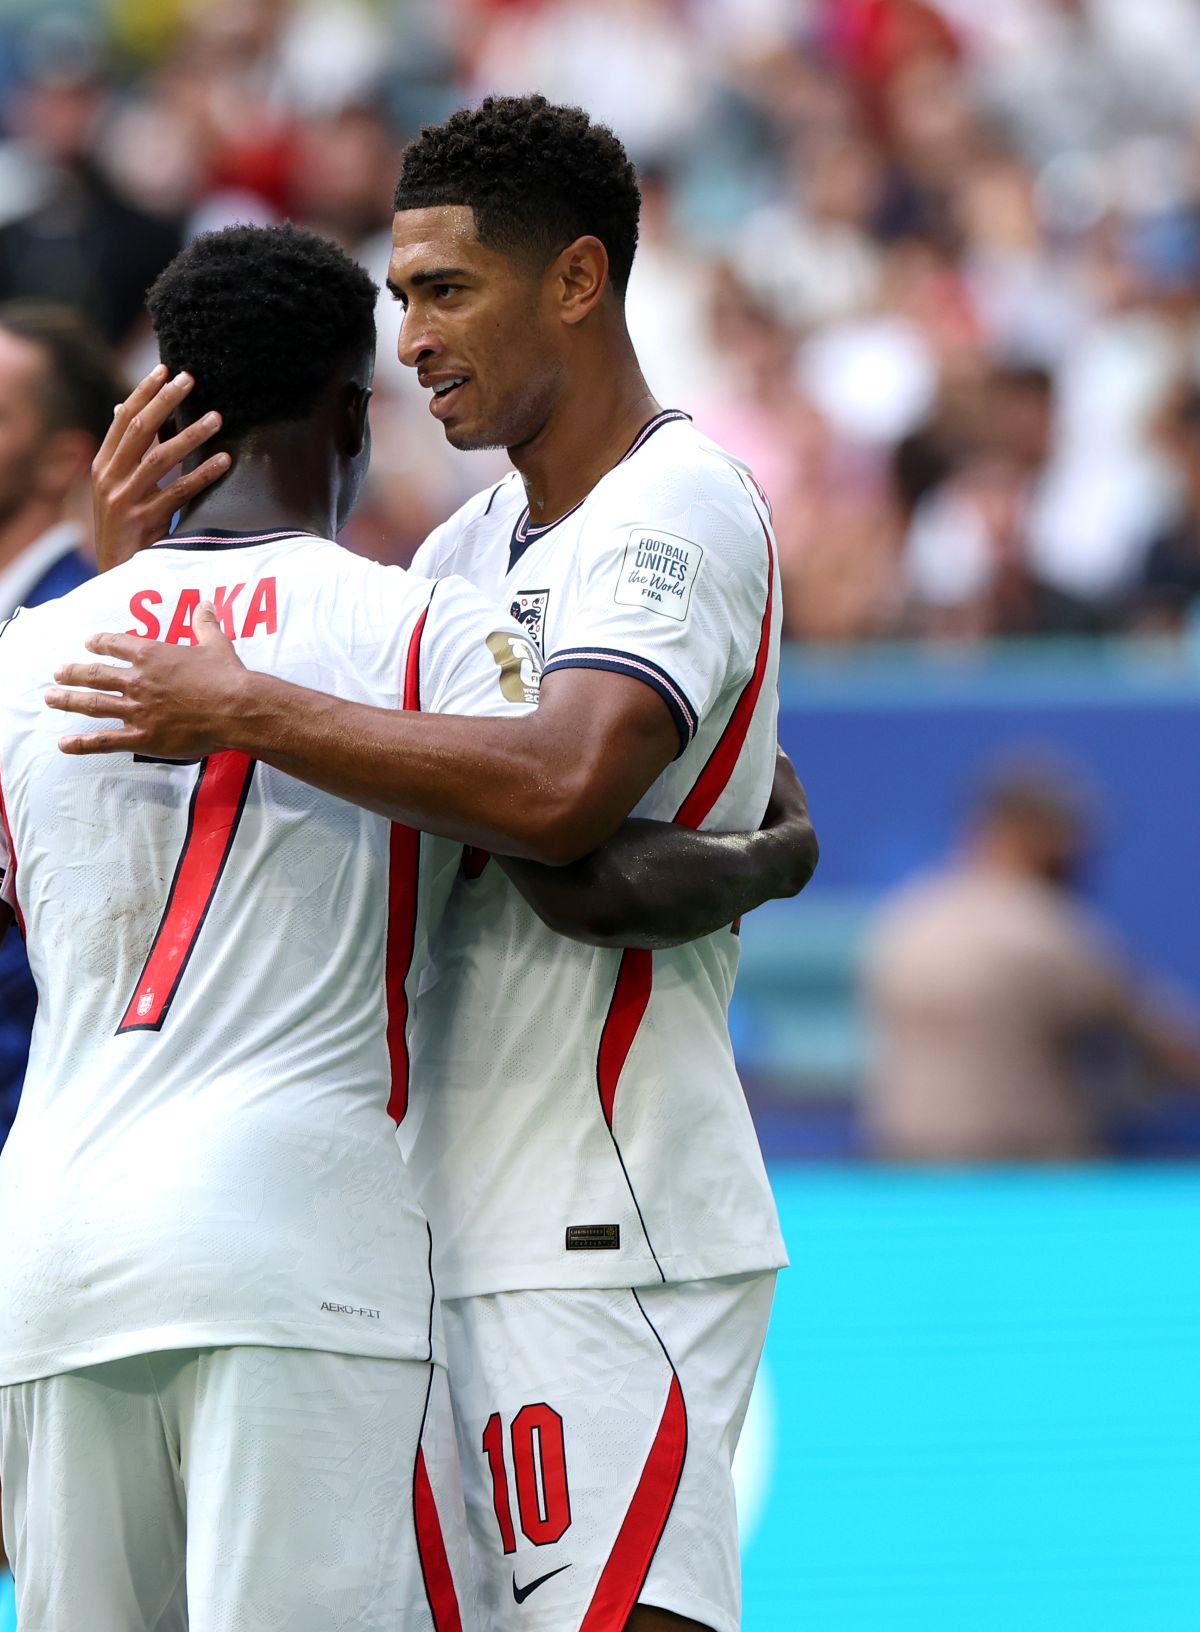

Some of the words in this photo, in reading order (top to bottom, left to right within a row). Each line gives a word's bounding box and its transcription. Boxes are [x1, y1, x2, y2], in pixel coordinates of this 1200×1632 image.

[635, 551, 687, 581] UNITES
[639, 538, 689, 565] FOOTBALL
[628, 570, 648, 583] the
[650, 573, 686, 599] World
[641, 588, 662, 602] FIFA
[126, 576, 278, 647] SAKA
[114, 745, 257, 1036] 7
[320, 1301, 381, 1319] AERO-FIT
[482, 1402, 572, 1556] 10
